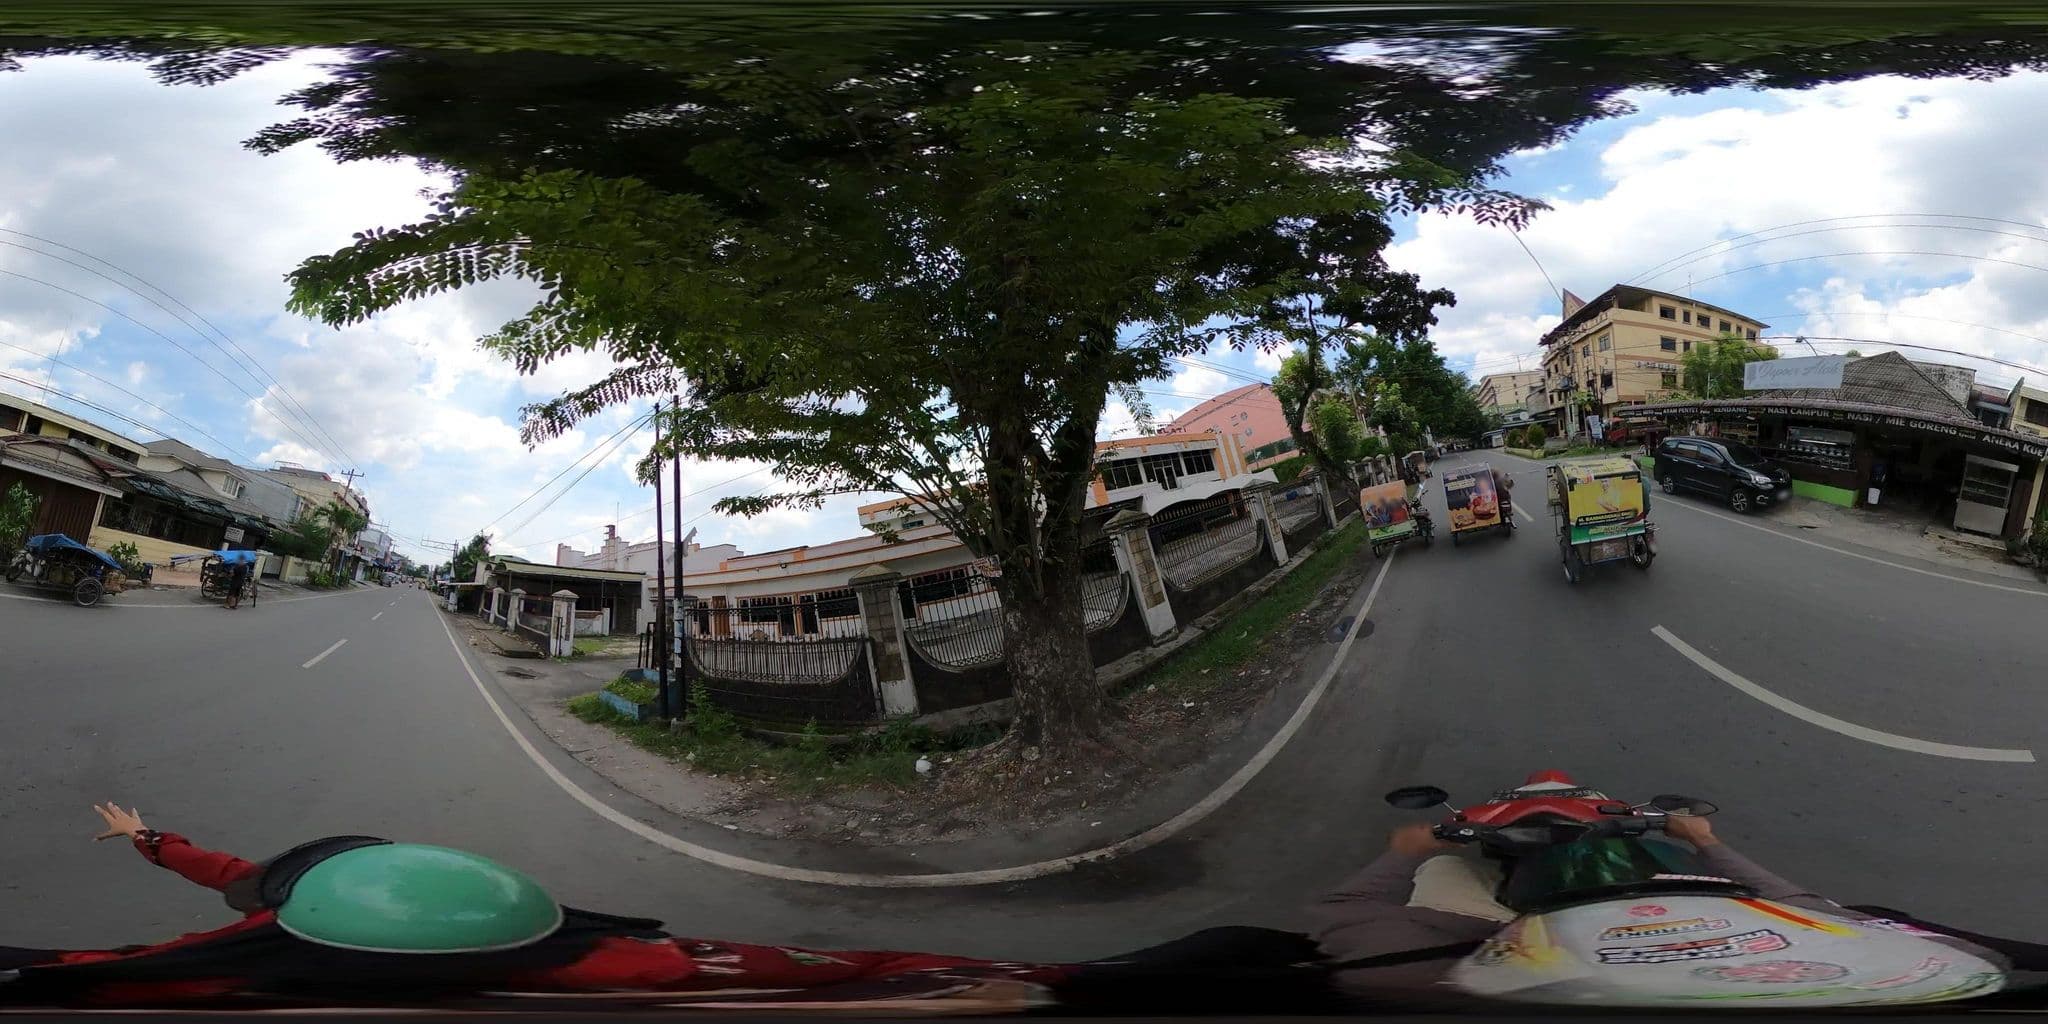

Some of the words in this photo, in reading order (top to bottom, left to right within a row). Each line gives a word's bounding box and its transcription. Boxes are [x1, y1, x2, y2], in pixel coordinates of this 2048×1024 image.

[1790, 407, 1830, 417] CAMPUR
[1847, 412, 1873, 422] NASI
[1885, 417, 1905, 427] MIE
[1909, 420, 1957, 435] GORENG
[1982, 434, 2020, 451] ANEKA
[2022, 442, 2045, 458] KUE
